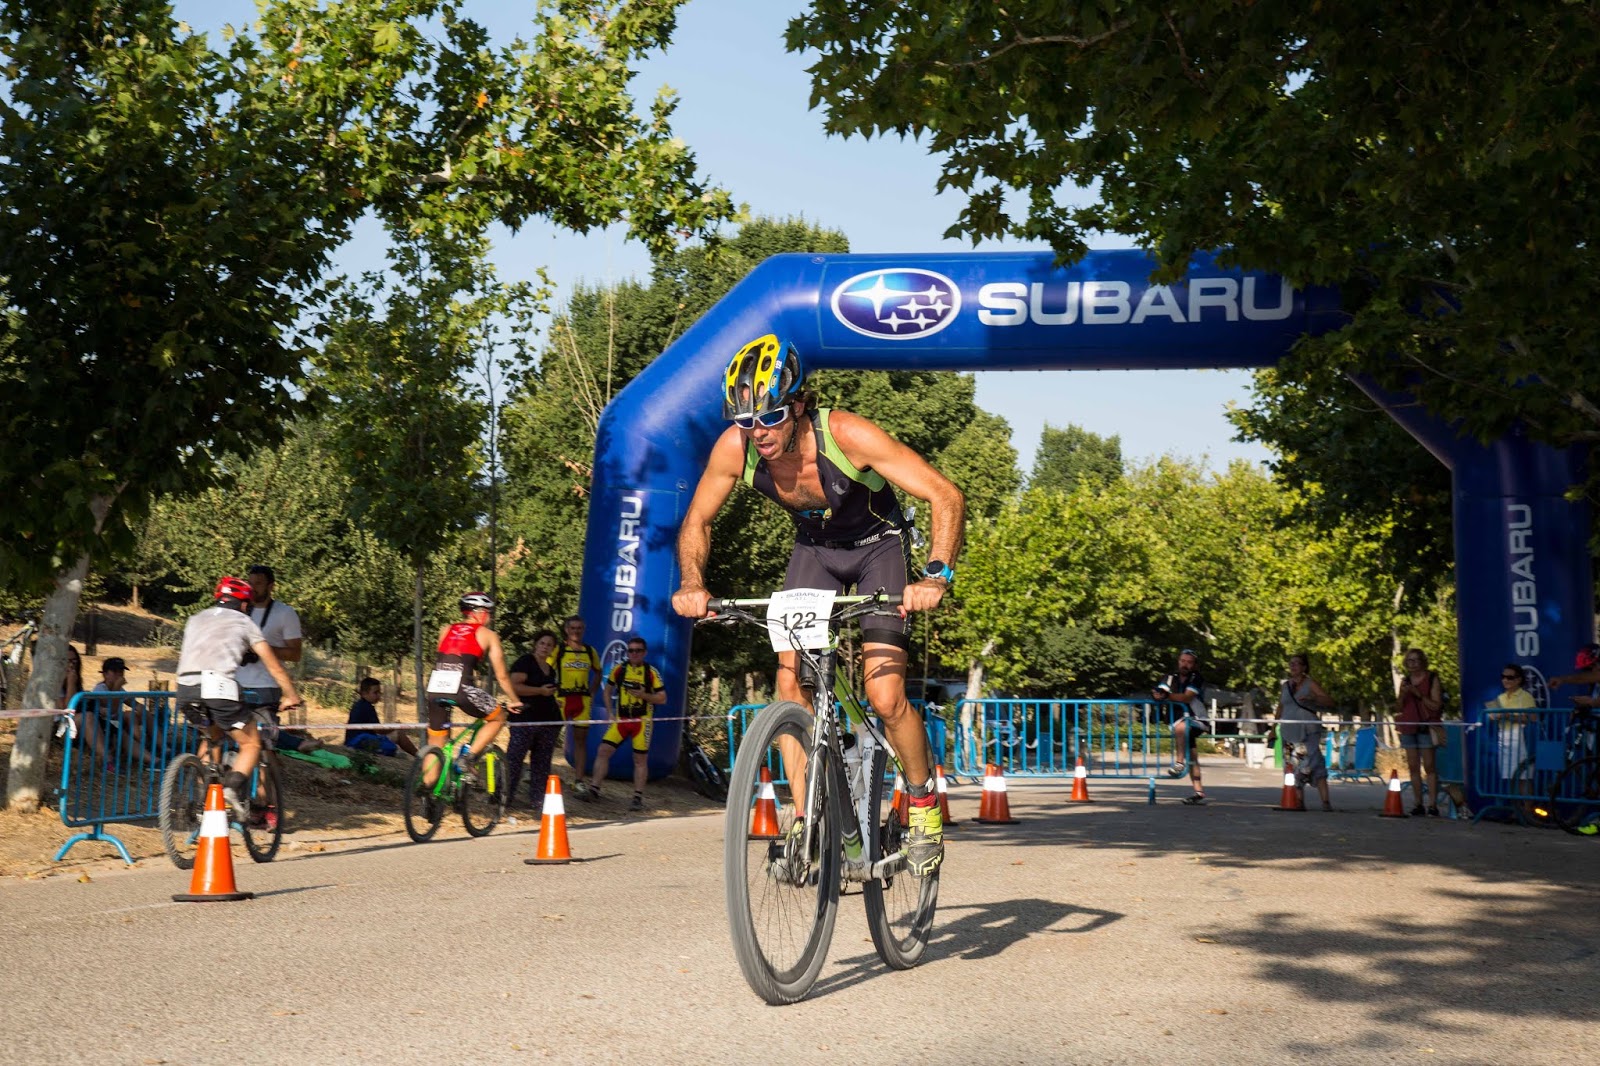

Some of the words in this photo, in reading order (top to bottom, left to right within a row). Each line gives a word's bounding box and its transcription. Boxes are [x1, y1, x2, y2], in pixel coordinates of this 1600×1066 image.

[978, 277, 1294, 326] SUBARU
[611, 496, 643, 633] SUBARU
[1507, 504, 1540, 657] SUBARU
[780, 611, 817, 631] 122
